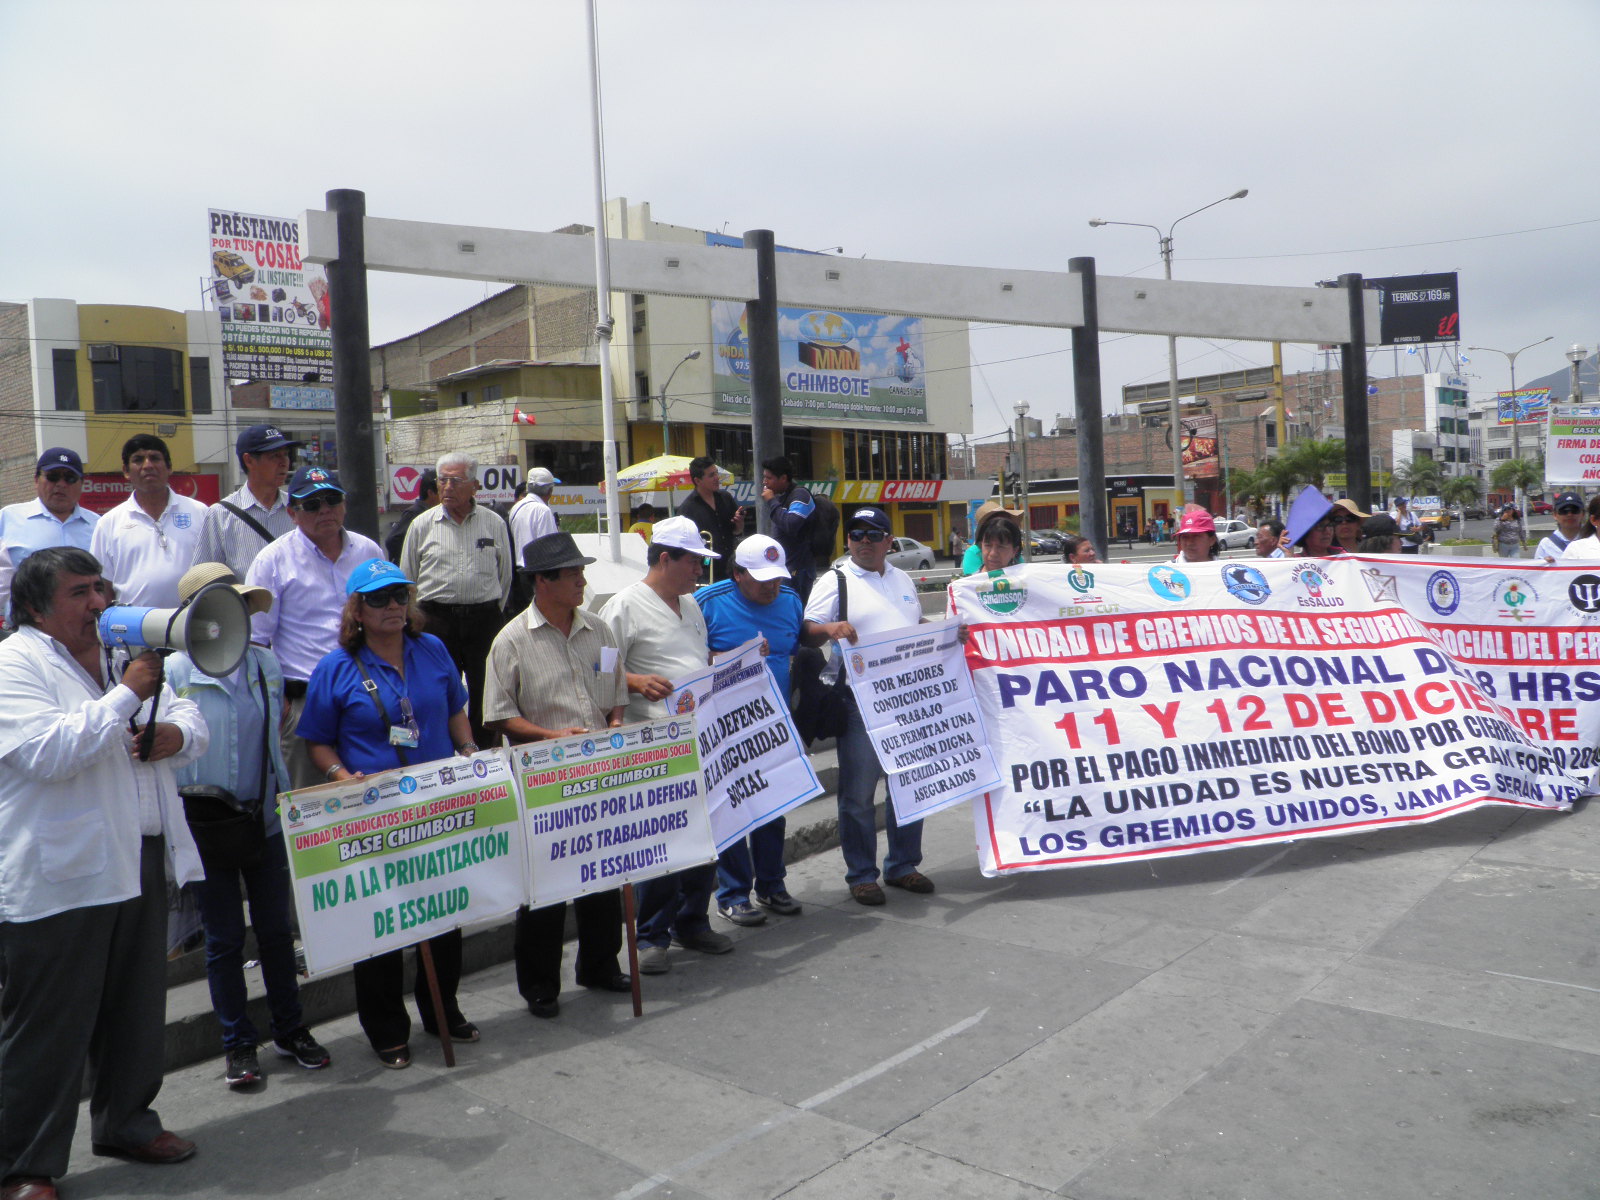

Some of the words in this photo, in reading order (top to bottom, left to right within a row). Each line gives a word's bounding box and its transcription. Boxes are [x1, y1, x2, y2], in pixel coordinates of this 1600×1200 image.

[210, 212, 298, 243] PRÉSTAMOS
[212, 238, 232, 249] POR
[233, 238, 254, 252] TUS
[255, 241, 302, 270] COSAS
[258, 270, 266, 284] AL
[267, 271, 304, 288] INSTANTE!!!
[1392, 292, 1418, 302] TERNOS
[236, 324, 260, 332] PUEDES
[261, 326, 280, 334] PAGAR
[282, 327, 290, 335] NO
[250, 333, 296, 346] PRÉSTAMOS
[298, 337, 332, 348] ILIMITAD
[815, 349, 860, 370] MMM
[787, 372, 870, 396] CHIMBOTE
[828, 401, 850, 412] Domingo
[1557, 439, 1586, 448] FIRMA
[1590, 438, 1600, 448] DE
[842, 482, 854, 500] Y
[860, 482, 880, 499] TE
[884, 482, 937, 499] CAMBIA
[1059, 606, 1085, 617] FED
[1096, 604, 1120, 615] CUT
[974, 625, 1090, 662] UNIDAD
[1094, 620, 1132, 654] DE
[1136, 614, 1260, 650] GREMIOS
[1260, 614, 1289, 644] DE
[1289, 617, 1320, 645] LA
[1319, 614, 1428, 646] SEGURID
[1431, 628, 1508, 659] SOCIAL
[1511, 632, 1554, 660] DEL
[1558, 632, 1600, 660] PER
[872, 679, 896, 694] POR
[898, 664, 944, 688] MEJORES
[873, 684, 942, 714] CONDICIONES
[942, 679, 959, 694] DE
[997, 665, 1148, 709] PARO
[1164, 654, 1406, 694] NACIONAL
[710, 722, 720, 751] LA
[720, 696, 776, 740] DEFENSA
[880, 736, 900, 754] QUE
[900, 719, 950, 748] PERMITAN
[951, 711, 976, 730] UNA
[895, 702, 942, 727] TRABAJO
[1054, 707, 1121, 750] 11
[1141, 700, 1181, 739] Y
[1206, 694, 1272, 734] 12
[1282, 692, 1355, 728] DE
[1361, 680, 1579, 740] DICIERE
[527, 772, 556, 788] UNIDAD
[558, 768, 568, 780] DE
[569, 757, 611, 779] SINDICATOS
[612, 756, 622, 768] DE
[622, 754, 630, 766] LA
[632, 746, 668, 764] SEGURIDAD
[670, 743, 692, 756] SOCIAL
[713, 762, 723, 786] LA
[722, 722, 790, 779] SEGURIDAD
[894, 742, 938, 769] ATENCIÓN
[939, 732, 974, 753] DIGNA
[900, 772, 911, 787] DE
[911, 755, 950, 782] CALIDAD
[952, 755, 962, 768] A
[962, 747, 982, 764] LOS
[1012, 758, 1070, 792] POR
[1074, 756, 1105, 785] EL
[1107, 746, 1180, 781] PAGO
[1182, 732, 1310, 772] INMEDIATO
[1312, 732, 1352, 759] DEL
[1352, 728, 1410, 756] BONO
[1410, 719, 1464, 751] POR
[1462, 714, 1523, 744] CIERRE
[562, 778, 598, 798] BASE
[601, 764, 668, 790] CHIMBOTE
[601, 795, 627, 818] POR
[630, 791, 644, 811] LA
[647, 779, 698, 808] DEFENSA
[726, 770, 769, 808] SOCIAL
[914, 768, 976, 804] ASEGURADOS
[1103, 776, 1240, 814] UNIDAD
[1250, 771, 1292, 796] ES
[1300, 760, 1436, 790] NUESTRA
[1442, 746, 1514, 770] GRAN
[296, 831, 331, 850] UNIDAD
[332, 827, 344, 840] DE
[345, 812, 400, 837] SINDICATOS
[402, 808, 414, 822] DE
[416, 806, 428, 820] LA
[429, 795, 478, 816] SEGURIDAD
[479, 786, 508, 804] SOCIAL
[1019, 830, 1088, 856] LOS
[1100, 808, 1256, 848] GREMIOS
[1265, 794, 1388, 826] UNIDOS,
[1396, 774, 1492, 811] JAMAS
[1494, 773, 1544, 802] SERÁN
[340, 834, 384, 862] BASE
[386, 810, 474, 849] CHIMBOTE
[551, 840, 567, 861] DE
[571, 832, 592, 854] LOS
[596, 810, 688, 848] TRABAJADORES
[312, 879, 338, 912] NO
[344, 874, 357, 903] A
[360, 866, 382, 898] LA
[384, 826, 509, 890] PRIVATIZACIÓN
[580, 862, 596, 883] DE
[601, 842, 668, 878] ESSALUD!!!
[374, 906, 395, 938] DE
[399, 886, 470, 930] ESSALUD
